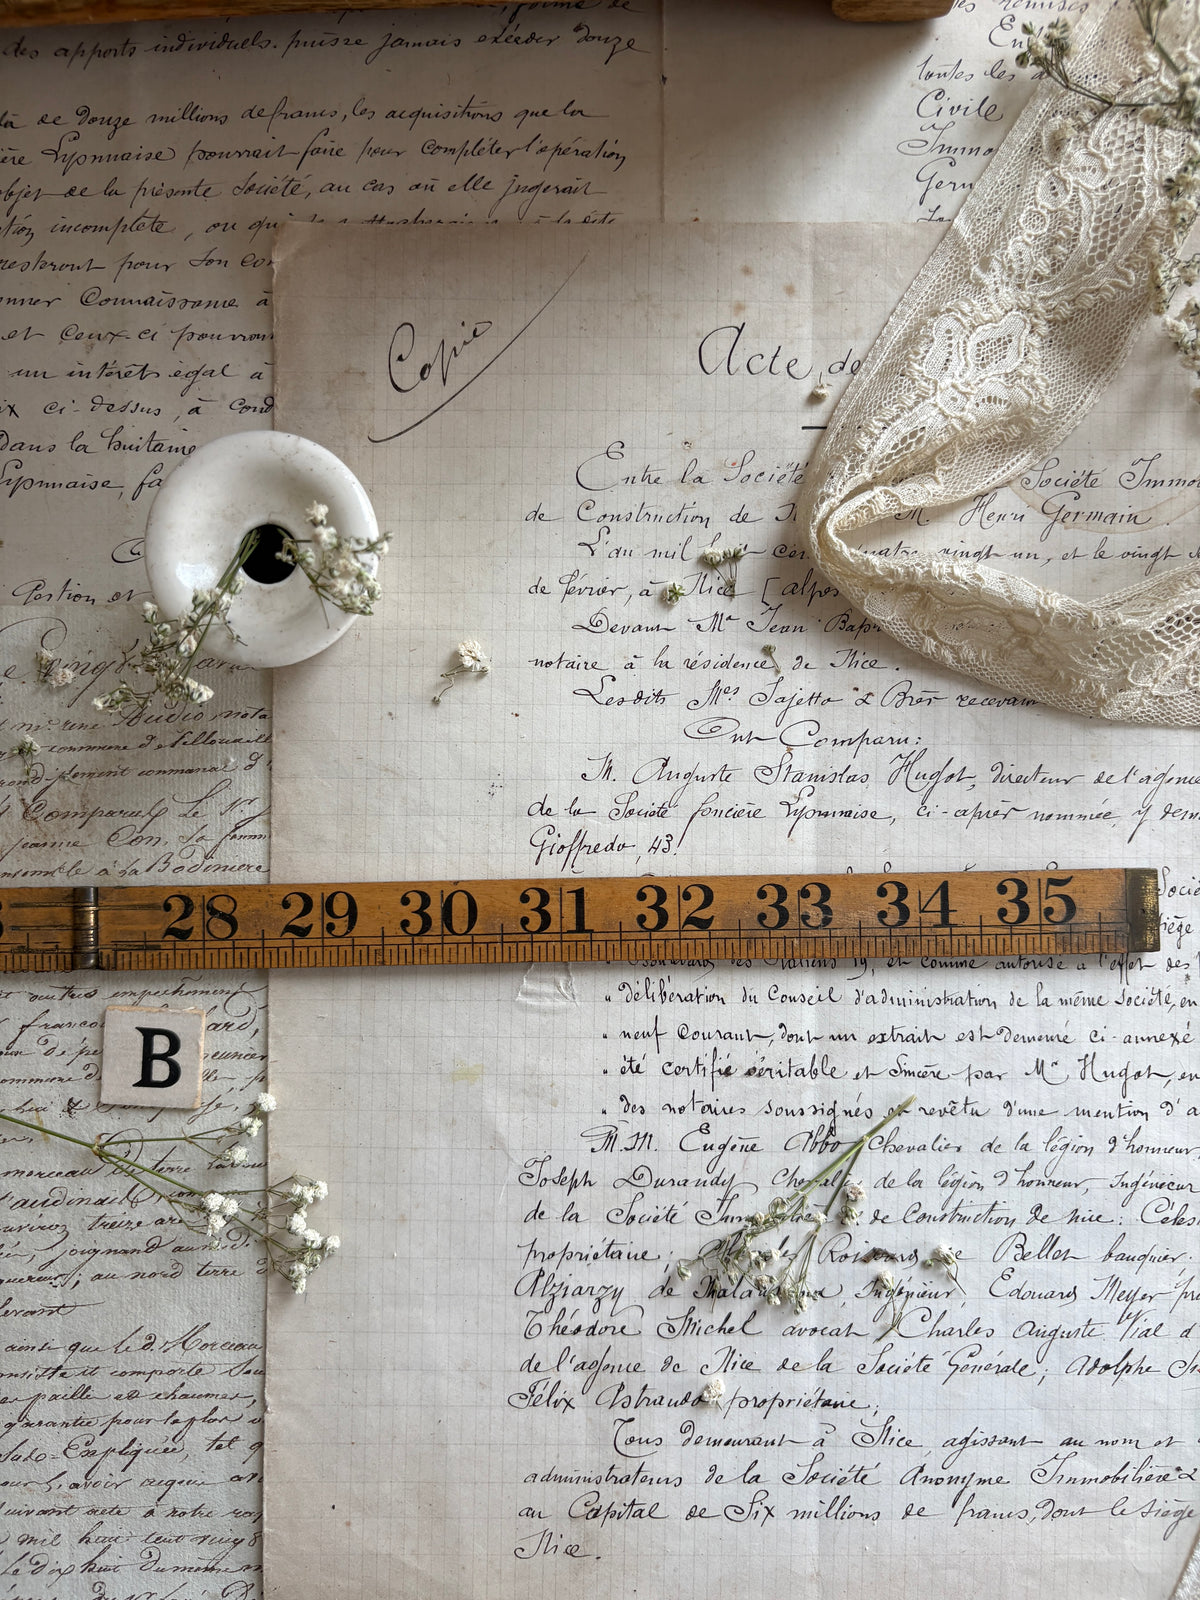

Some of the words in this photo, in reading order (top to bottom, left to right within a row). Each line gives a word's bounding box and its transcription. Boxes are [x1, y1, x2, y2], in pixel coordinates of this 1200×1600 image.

[54, 39, 137, 70] apports
[365, 23, 461, 65] jamais
[916, 54, 975, 82] toutes
[984, 59, 1016, 81] les
[149, 101, 230, 125] millions
[352, 98, 376, 120] les
[385, 94, 503, 130] acquisitions
[513, 106, 556, 130] que
[563, 100, 610, 117] la
[916, 88, 1004, 122] Civile
[356, 137, 408, 164] pour
[103, 176, 126, 197] la
[447, 173, 495, 192] elle
[113, 252, 177, 283] pour
[67, 359, 160, 380] intérêt
[250, 362, 274, 380] à
[388, 320, 494, 393] Copie
[698, 321, 813, 380] Acte
[827, 348, 862, 376] de
[69, 431, 96, 454] la
[576, 440, 663, 492] Entre
[681, 458, 714, 484] la
[723, 450, 809, 485] Société
[1021, 458, 1106, 490] Société
[524, 503, 562, 522] de
[576, 499, 712, 528] Construction
[730, 504, 764, 523] de
[959, 492, 1027, 530] Henri
[578, 526, 634, 557] L'an
[644, 535, 692, 561] mil
[1013, 551, 1051, 567] un,
[1093, 537, 1115, 559] le
[1115, 550, 1182, 576] vingt
[529, 576, 551, 595] de
[639, 580, 667, 597] à
[572, 606, 676, 634] Devant
[747, 604, 808, 634] Jean
[528, 652, 609, 671] notaire
[623, 654, 644, 671] à
[653, 652, 675, 669] la
[684, 650, 775, 671] résidence
[792, 653, 816, 670] de
[684, 717, 775, 741] Ont
[633, 756, 742, 808] Auguste
[754, 752, 870, 786] Stanislas
[990, 762, 1084, 785] directeur
[528, 794, 561, 817] de
[565, 797, 596, 815] la
[608, 791, 677, 821] Société
[1127, 804, 1152, 843] y
[162, 894, 239, 941] 28
[280, 891, 359, 938] 29
[400, 889, 478, 936] 30
[519, 887, 595, 934] 31
[636, 883, 715, 931] 32
[757, 882, 833, 930] 33
[876, 880, 958, 928] 34
[997, 876, 1077, 925] 35
[1166, 955, 1190, 970] des
[742, 986, 758, 1004] du
[768, 984, 842, 1006] Conseil
[1009, 989, 1029, 1007] de
[1036, 982, 1052, 1007] la
[1060, 990, 1109, 1007] même
[620, 1014, 668, 1054] neuf
[830, 1032, 856, 1041] un
[956, 1025, 996, 1042] est
[131, 1026, 182, 1088] B
[620, 1052, 646, 1075] été
[662, 1047, 738, 1092] certifié
[951, 1064, 1009, 1086] par
[620, 1094, 646, 1115] des
[662, 1090, 746, 1115] notaires
[919, 1097, 990, 1118] revêtu
[1003, 1100, 1059, 1116] d'une
[1068, 1101, 1149, 1120] mention
[679, 1122, 764, 1173] Eugène
[868, 1127, 962, 1152] Chevalier
[981, 1136, 1003, 1152] de
[1014, 1132, 1032, 1152] la
[1043, 1126, 1094, 1178] légion
[518, 1155, 598, 1192] Joseph
[938, 1169, 985, 1208] légion
[524, 1200, 553, 1224] de
[562, 1202, 589, 1222] la
[607, 1192, 687, 1226] Société
[1026, 1205, 1062, 1224] de
[648, 1274, 680, 1298] de
[524, 1308, 641, 1339] Théodore
[657, 1306, 763, 1338] Michel
[782, 1322, 869, 1337] avocat
[896, 1306, 995, 1338] Charles
[520, 1356, 555, 1373] de
[661, 1356, 680, 1372] de
[701, 1346, 762, 1375] Nice
[857, 1343, 949, 1376] Société
[508, 1378, 576, 1413] Félix
[1060, 1437, 1083, 1447] au
[1094, 1437, 1147, 1448] nom
[1154, 1434, 1184, 1448] et
[524, 1462, 683, 1487] administrateurs
[705, 1465, 736, 1485] de
[782, 1452, 881, 1485] Société
[518, 1506, 552, 1520] au
[568, 1491, 669, 1528] Capital
[724, 1490, 775, 1527] Six
[788, 1496, 881, 1520] millions
[1110, 1497, 1137, 1517] le
